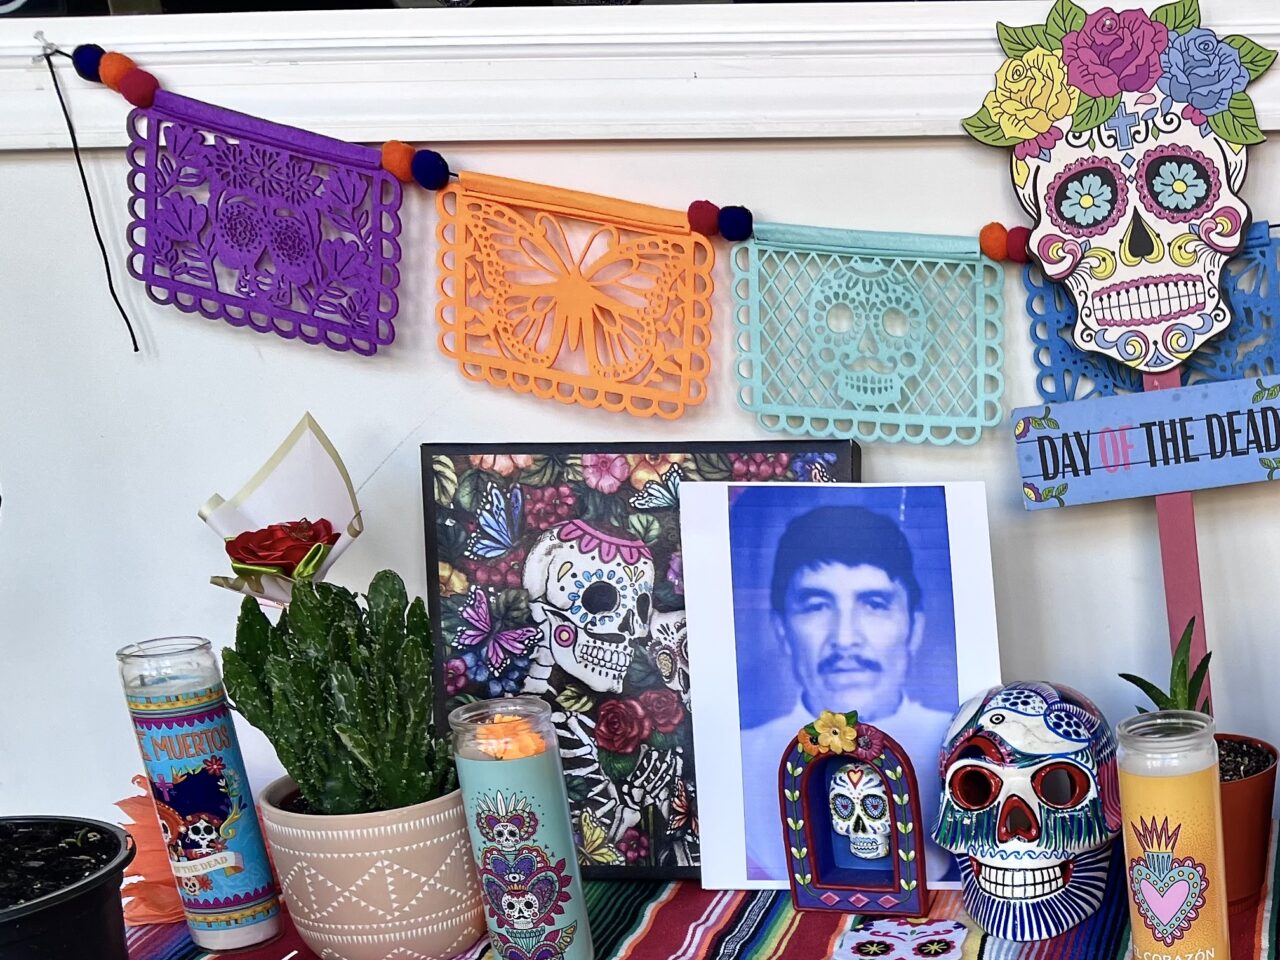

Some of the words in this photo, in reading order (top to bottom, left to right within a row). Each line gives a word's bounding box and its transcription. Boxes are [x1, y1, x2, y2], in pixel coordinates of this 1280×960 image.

[1037, 429, 1092, 481] DAY
[1099, 424, 1135, 474] OF
[1139, 416, 1200, 468] THE
[151, 725, 231, 761] MUERTOS
[200, 856, 228, 871] DEAD
[1133, 944, 1142, 959] EL
